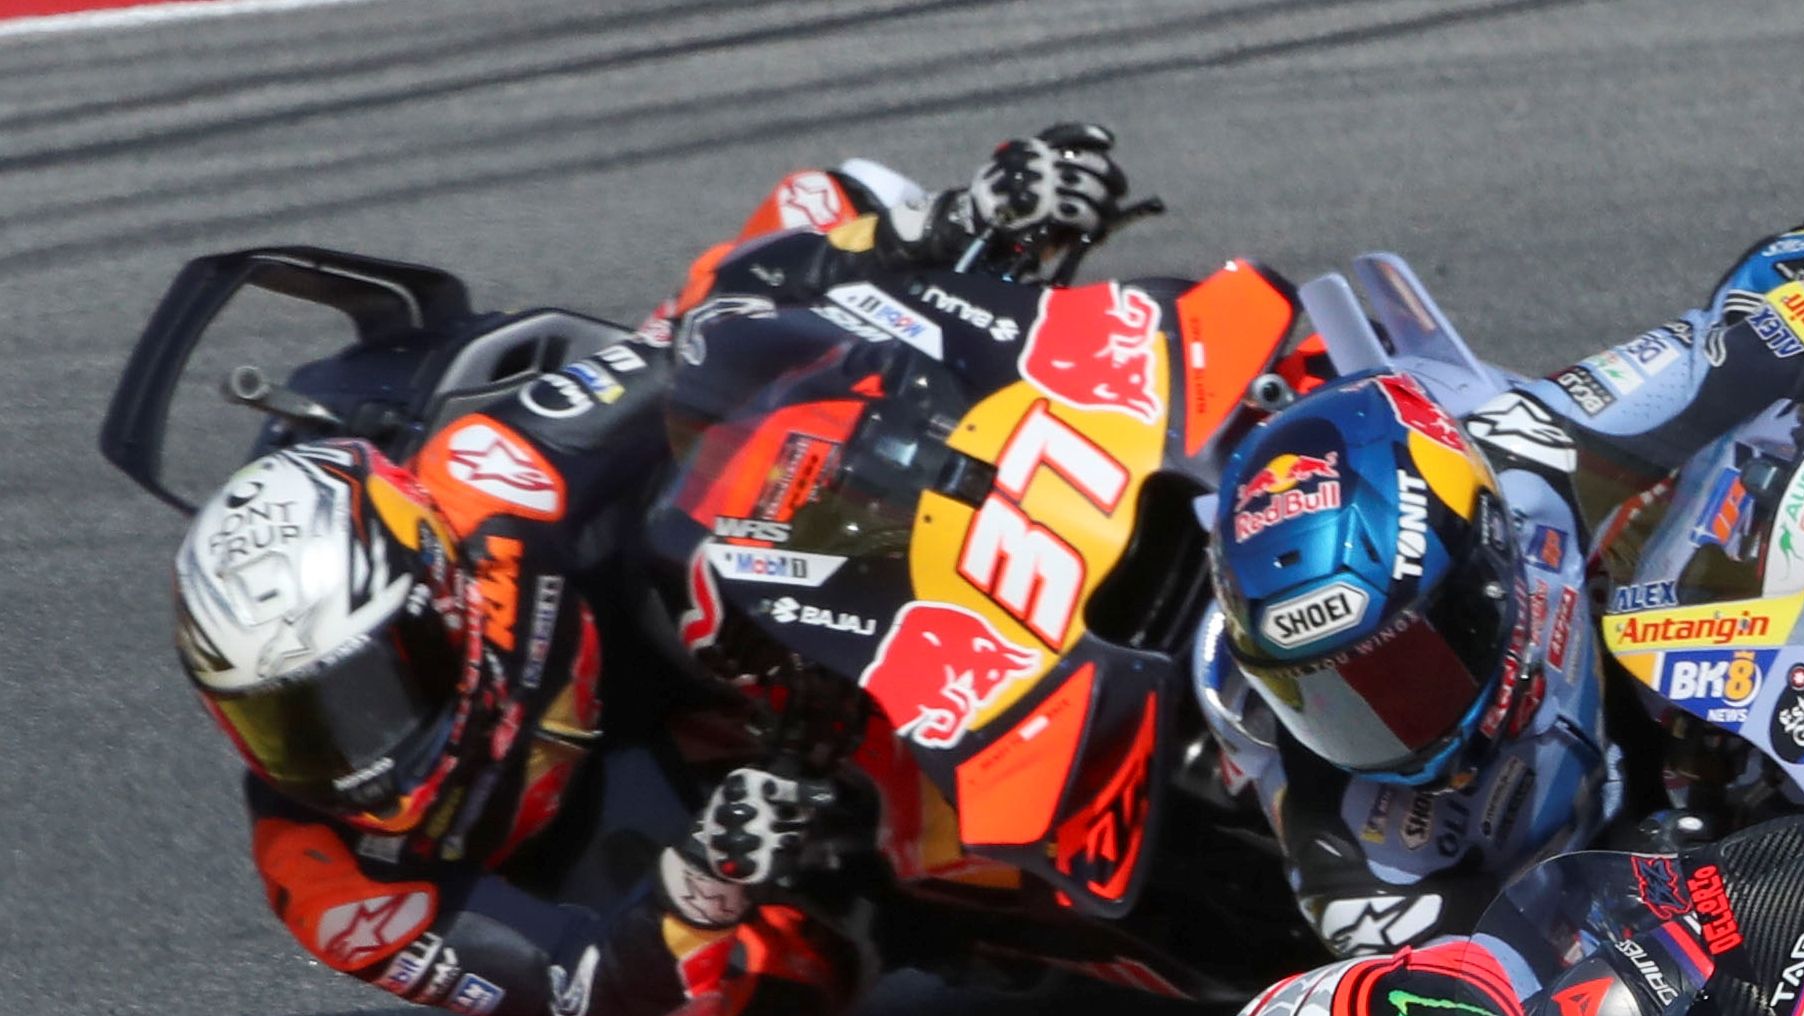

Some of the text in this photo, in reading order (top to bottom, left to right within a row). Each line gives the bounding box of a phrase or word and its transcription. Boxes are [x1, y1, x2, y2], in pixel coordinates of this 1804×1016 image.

[921, 286, 994, 328] BAJAJ
[1747, 307, 1804, 357] ALEX
[957, 398, 1131, 652] 37
[1235, 480, 1341, 543] Red Bull
[736, 552, 808, 579] Mobil 1
[475, 534, 524, 653] KTM
[1274, 593, 1353, 639] SHOEI
[1613, 580, 1680, 612] ALEX
[799, 605, 877, 636] BAJAJ
[1619, 610, 1769, 645] Antangin
[1670, 650, 1763, 704] BK8
[1707, 708, 1749, 723] NEWS
[1405, 792, 1434, 838] SHO
[1618, 939, 1680, 1006] DAINESE
